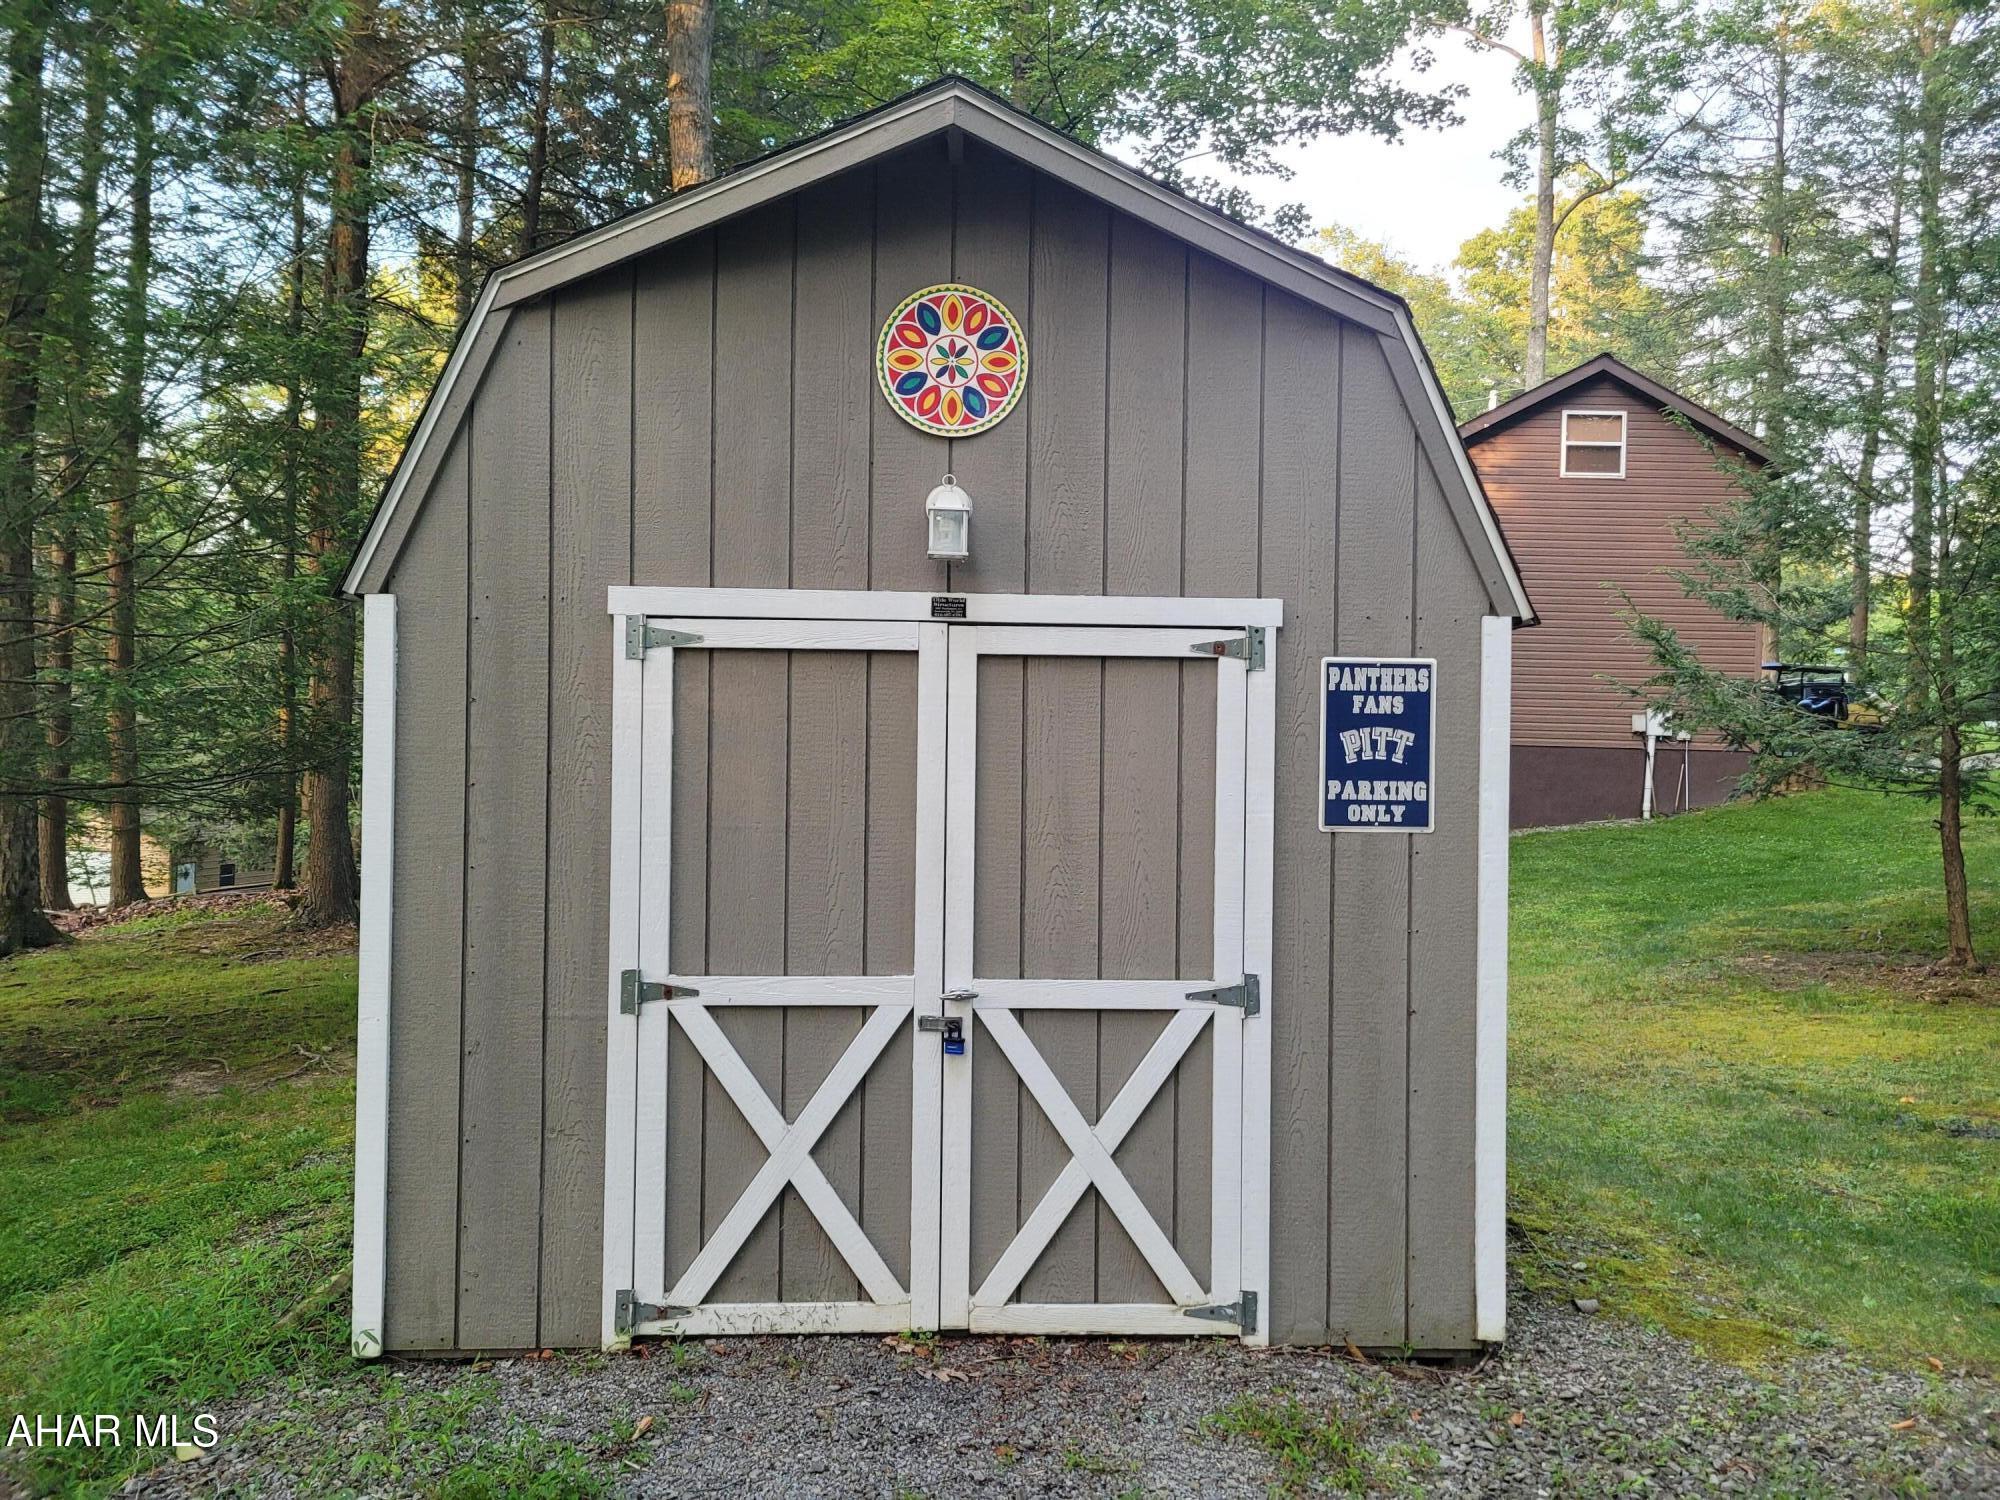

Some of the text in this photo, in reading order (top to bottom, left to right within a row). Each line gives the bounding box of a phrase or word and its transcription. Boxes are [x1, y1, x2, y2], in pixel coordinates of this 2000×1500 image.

[1328, 667, 1429, 692] PANTHERS
[1352, 695, 1404, 714] FANS
[1340, 726, 1415, 764] PITT
[1327, 780, 1427, 801] PARKING
[1347, 804, 1405, 823] ONLY
